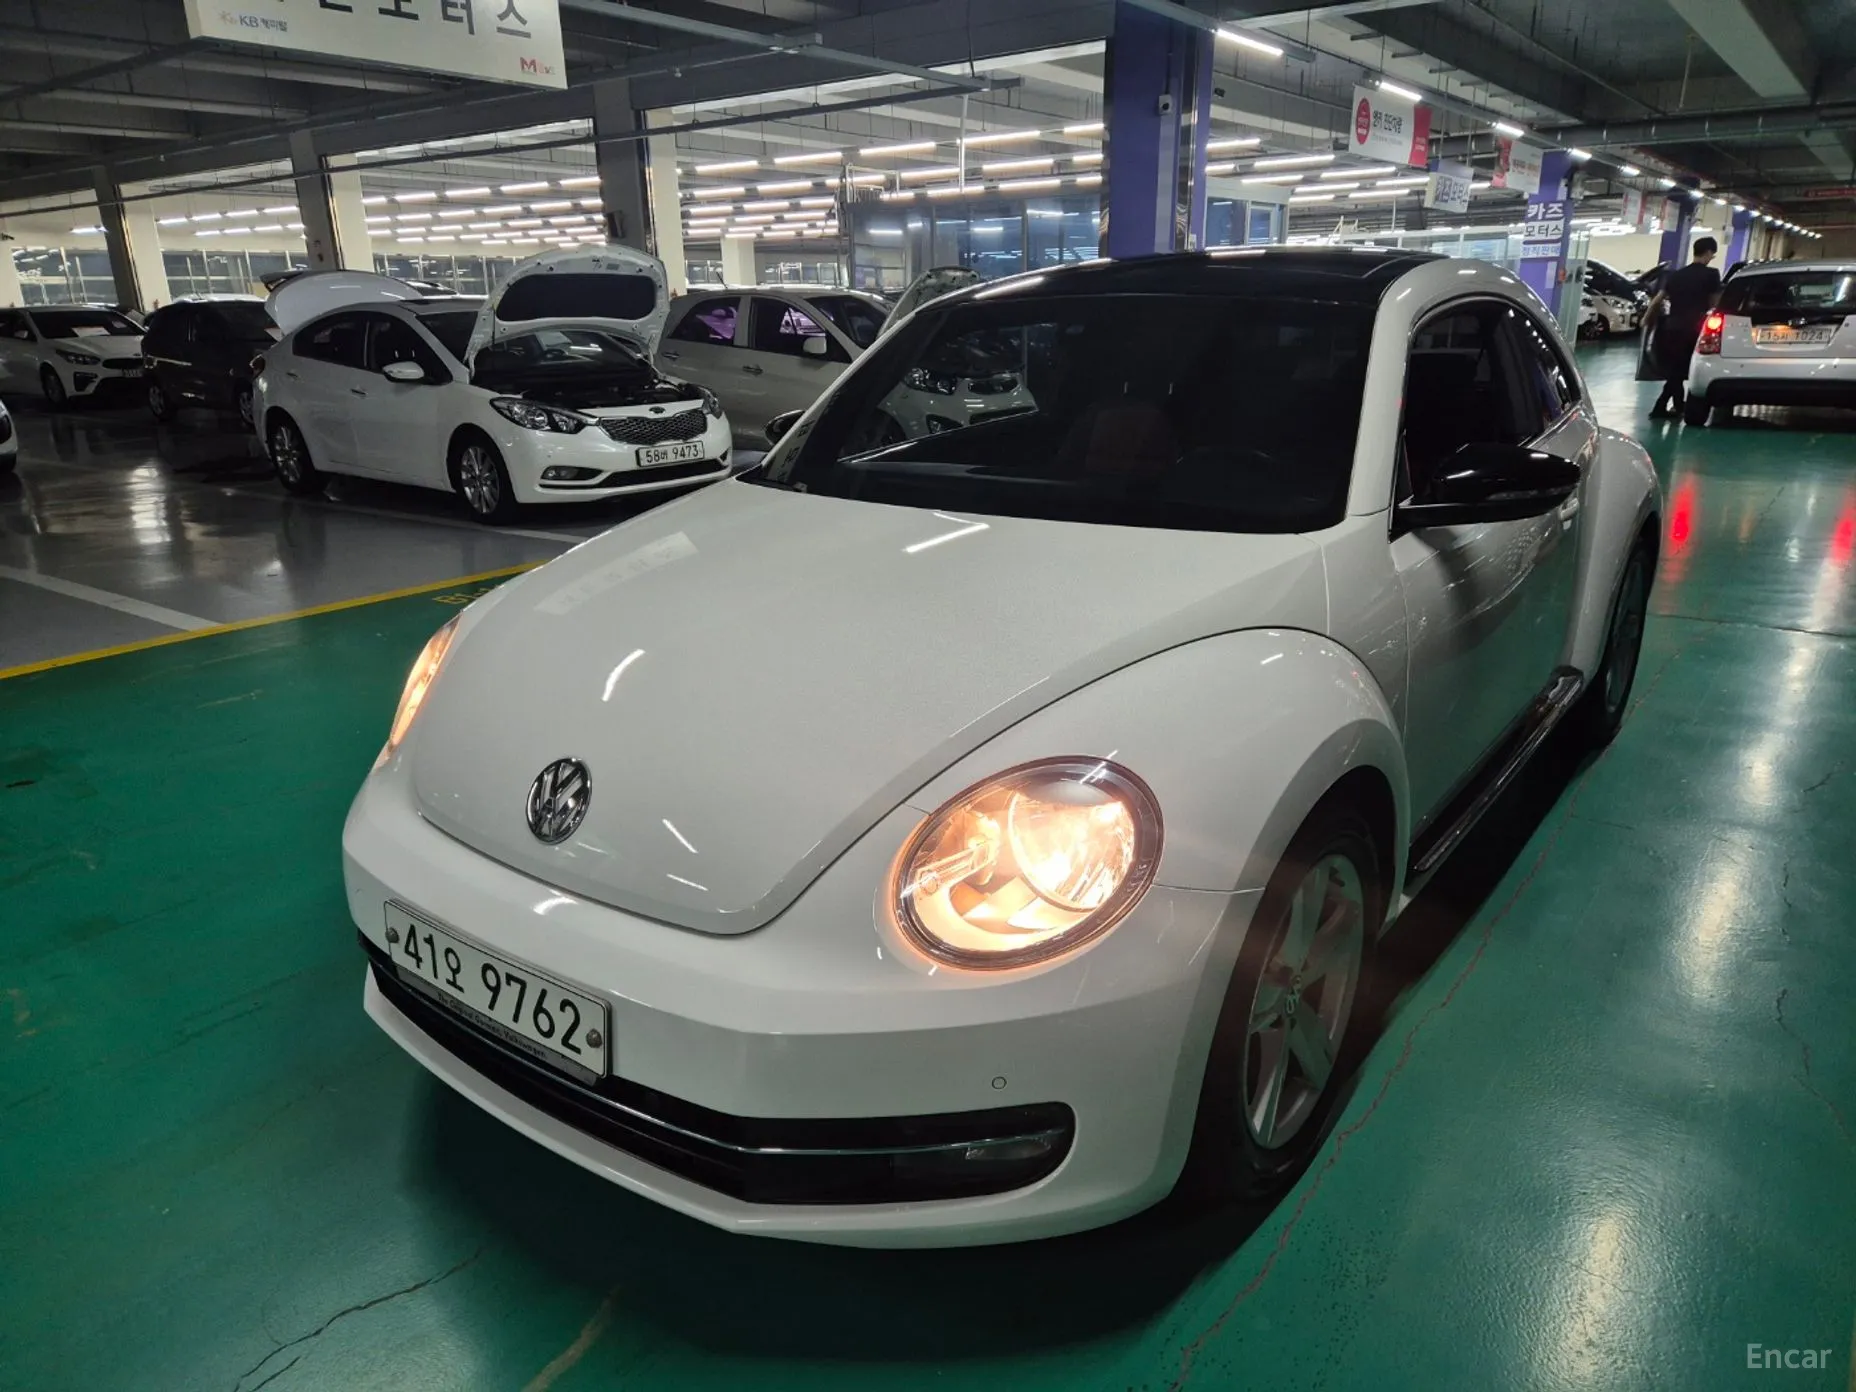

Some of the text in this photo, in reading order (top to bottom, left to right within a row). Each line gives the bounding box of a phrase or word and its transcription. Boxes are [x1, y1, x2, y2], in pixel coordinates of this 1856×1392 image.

[1527, 203, 1564, 219] 카즈
[1524, 224, 1562, 237] 모터스
[672, 445, 699, 459] 9473
[404, 923, 582, 1055] 41오 9762
